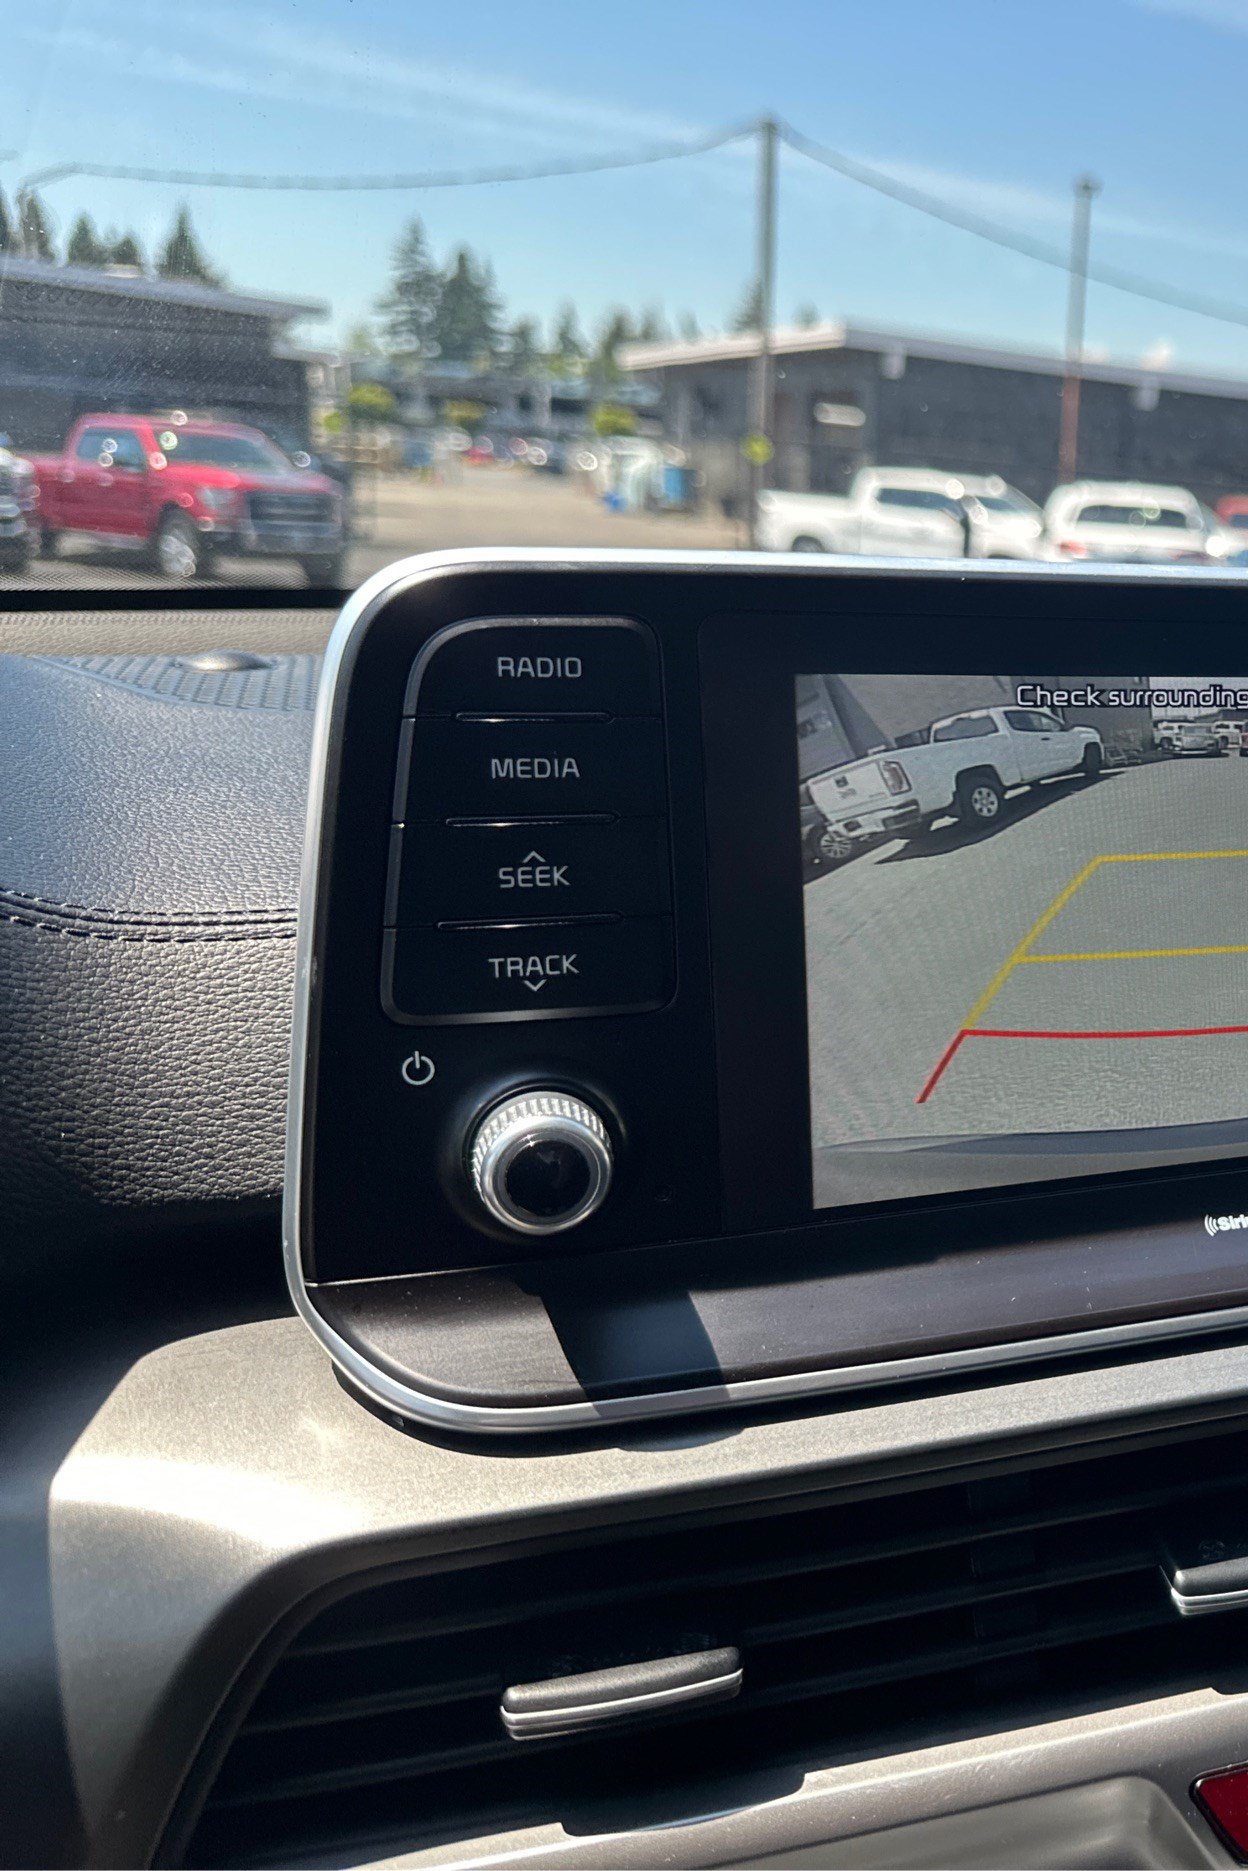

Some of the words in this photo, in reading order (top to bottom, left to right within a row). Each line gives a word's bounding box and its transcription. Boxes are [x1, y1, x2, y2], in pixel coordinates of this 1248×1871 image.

[497, 656, 583, 679] RADIO
[1016, 685, 1102, 707] Check
[490, 757, 580, 779] MEDIA
[499, 865, 571, 888] SEEK
[488, 954, 580, 979] TRACK
